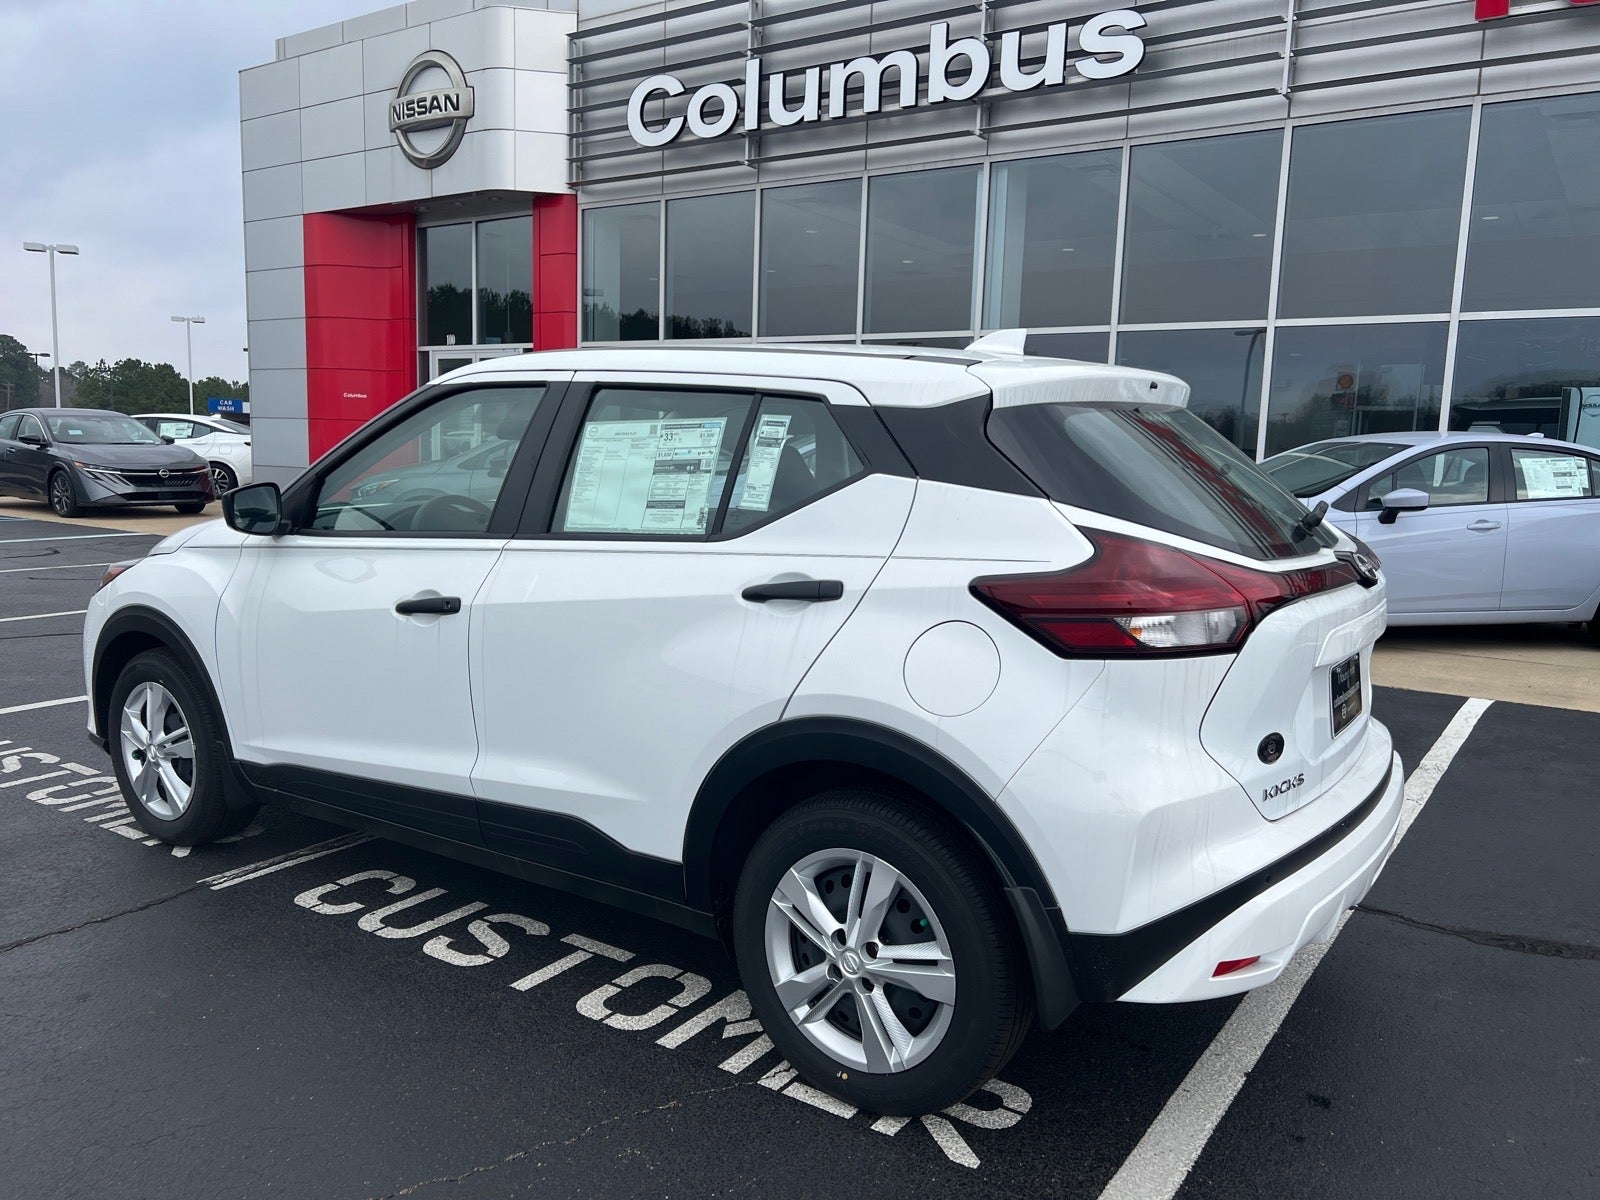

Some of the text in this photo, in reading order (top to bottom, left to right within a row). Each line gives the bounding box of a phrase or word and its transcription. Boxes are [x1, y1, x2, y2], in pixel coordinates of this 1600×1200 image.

[627, 9, 1147, 148] Columbus
[392, 93, 460, 123] NISSAN
[664, 432, 674, 441] 33
[1263, 773, 1305, 802] KICKS
